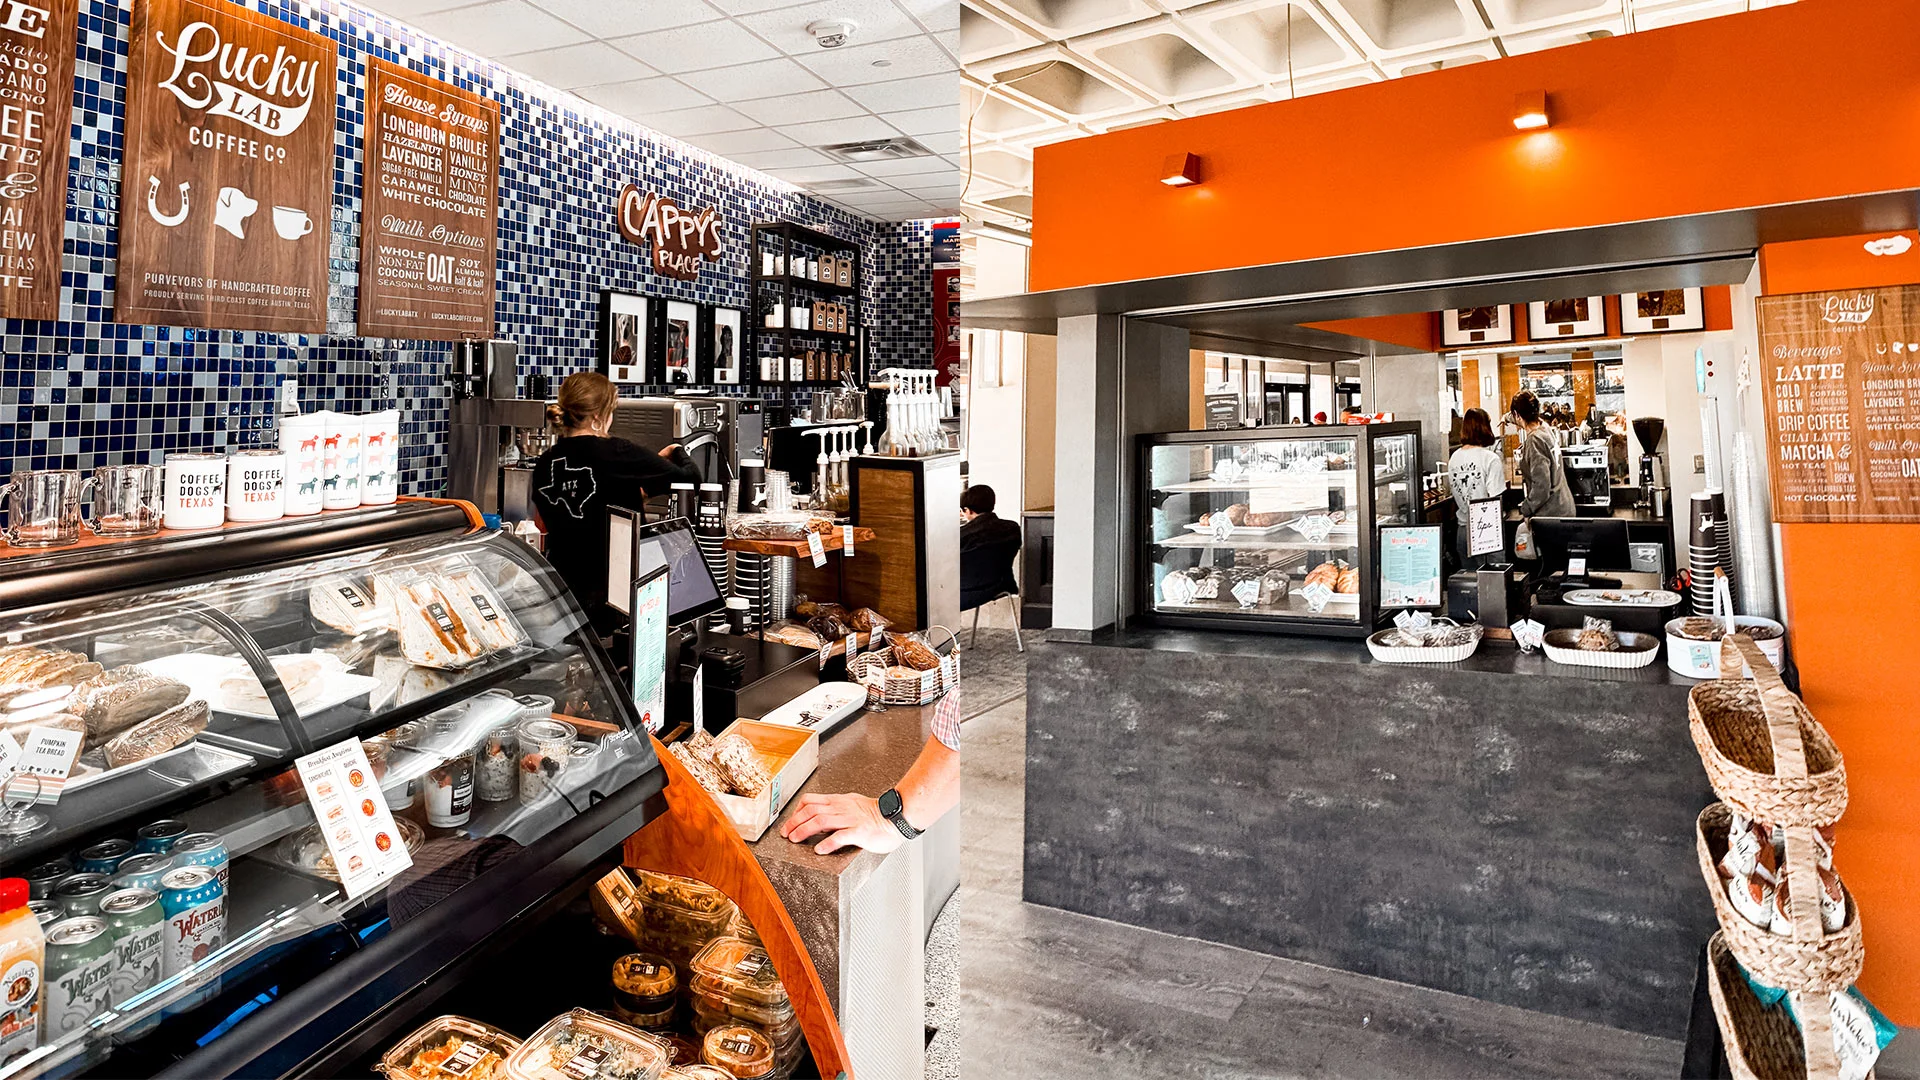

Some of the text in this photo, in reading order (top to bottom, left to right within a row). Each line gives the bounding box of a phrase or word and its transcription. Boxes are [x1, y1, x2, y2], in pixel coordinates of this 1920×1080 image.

[156, 21, 319, 110] Lucky
[228, 92, 282, 130] LAB
[384, 83, 489, 133] House Syrups
[382, 112, 446, 146] LONGHORN
[189, 126, 259, 159] COFFEE
[383, 132, 443, 156] HAZELNUT
[382, 143, 442, 173] LAVENDER
[449, 151, 487, 173] VANILLA
[381, 161, 442, 184] SUGAR-FREE VANILLA
[449, 165, 487, 183] HONEY
[381, 174, 442, 197] CARAMEL
[449, 176, 487, 195] MINT
[381, 186, 487, 218] WHITE CHOCOLATE
[448, 189, 487, 207] CHOCOLATE
[381, 214, 485, 248] Milk Options
[624, 190, 722, 256] CAPPY'S
[379, 245, 426, 260] WHOLE
[379, 256, 426, 270] NON-FAT
[427, 253, 455, 284] OAT
[459, 258, 481, 269] SOY
[658, 249, 700, 274] PLACE
[378, 267, 425, 281] COCONUT
[455, 267, 485, 277] ALMOND
[144, 272, 311, 298] PURVEYORS OF HANDCRAFTED COFFEE
[377, 279, 484, 296] SEASONAL SWEET CREAM
[454, 275, 484, 288] half & half
[144, 289, 174, 299] PROUDLY
[176, 291, 205, 301] SERVING
[206, 295, 225, 303] THIRD
[226, 296, 245, 304] COAST
[247, 297, 268, 306] COFFEE
[294, 301, 311, 310] TEXAS
[1819, 293, 1875, 323] Lucky
[1844, 313, 1863, 321] LAB
[1772, 344, 1843, 360] Beverages
[1776, 363, 1845, 382] LATTE
[1776, 383, 1800, 398] COLD
[1862, 379, 1905, 390] LONGHORN
[1777, 398, 1803, 413] BREW
[1864, 398, 1905, 408] LAVENDER
[1778, 413, 1850, 431] DRIP COFFEE
[1780, 431, 1851, 443] CHAI LATTE
[1869, 439, 1897, 451] Milk
[1781, 443, 1852, 461] MATCHA &
[244, 469, 280, 480] COFFEE
[1833, 461, 1850, 472] THAI
[180, 474, 219, 484] COFFEE
[562, 480, 578, 491] ATX
[1834, 472, 1855, 483] BREW
[180, 486, 209, 496] DOGS
[244, 481, 272, 491] DOGS
[179, 497, 214, 508] TEXAS
[244, 491, 276, 502] TEXAS
[1804, 494, 1857, 502] CHOCOLATE
[1477, 517, 1493, 538] tips
[41, 738, 67, 747] PUMPKIN
[36, 746, 65, 756] TEA BREAD
